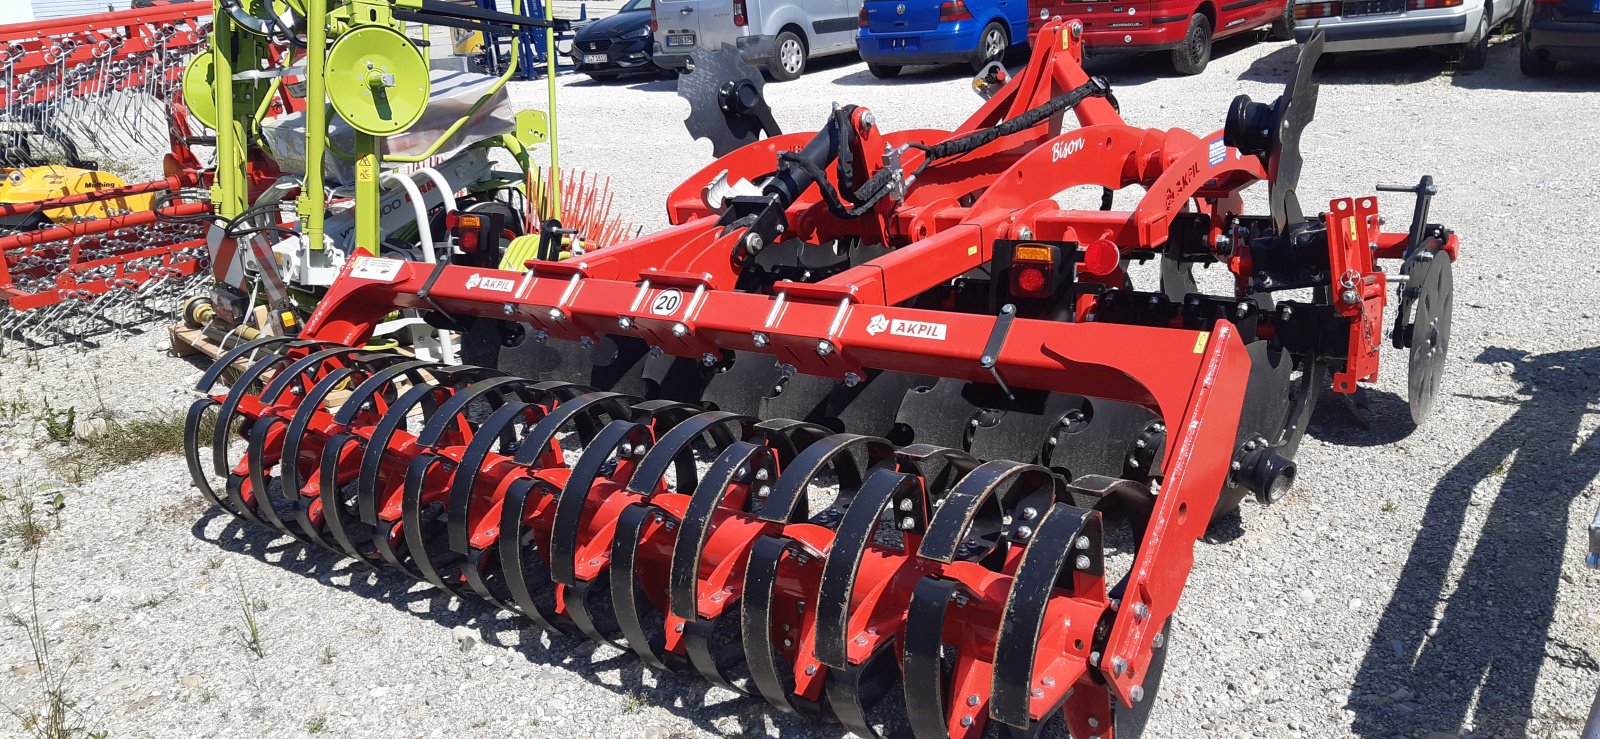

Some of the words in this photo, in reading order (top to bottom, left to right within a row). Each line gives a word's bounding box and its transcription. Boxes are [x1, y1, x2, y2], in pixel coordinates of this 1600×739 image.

[1051, 137, 1086, 163] Bison
[1176, 161, 1200, 196] AKPIL
[483, 279, 510, 290] AKPIL
[655, 295, 678, 310] 20
[896, 322, 938, 337] AKPIL
